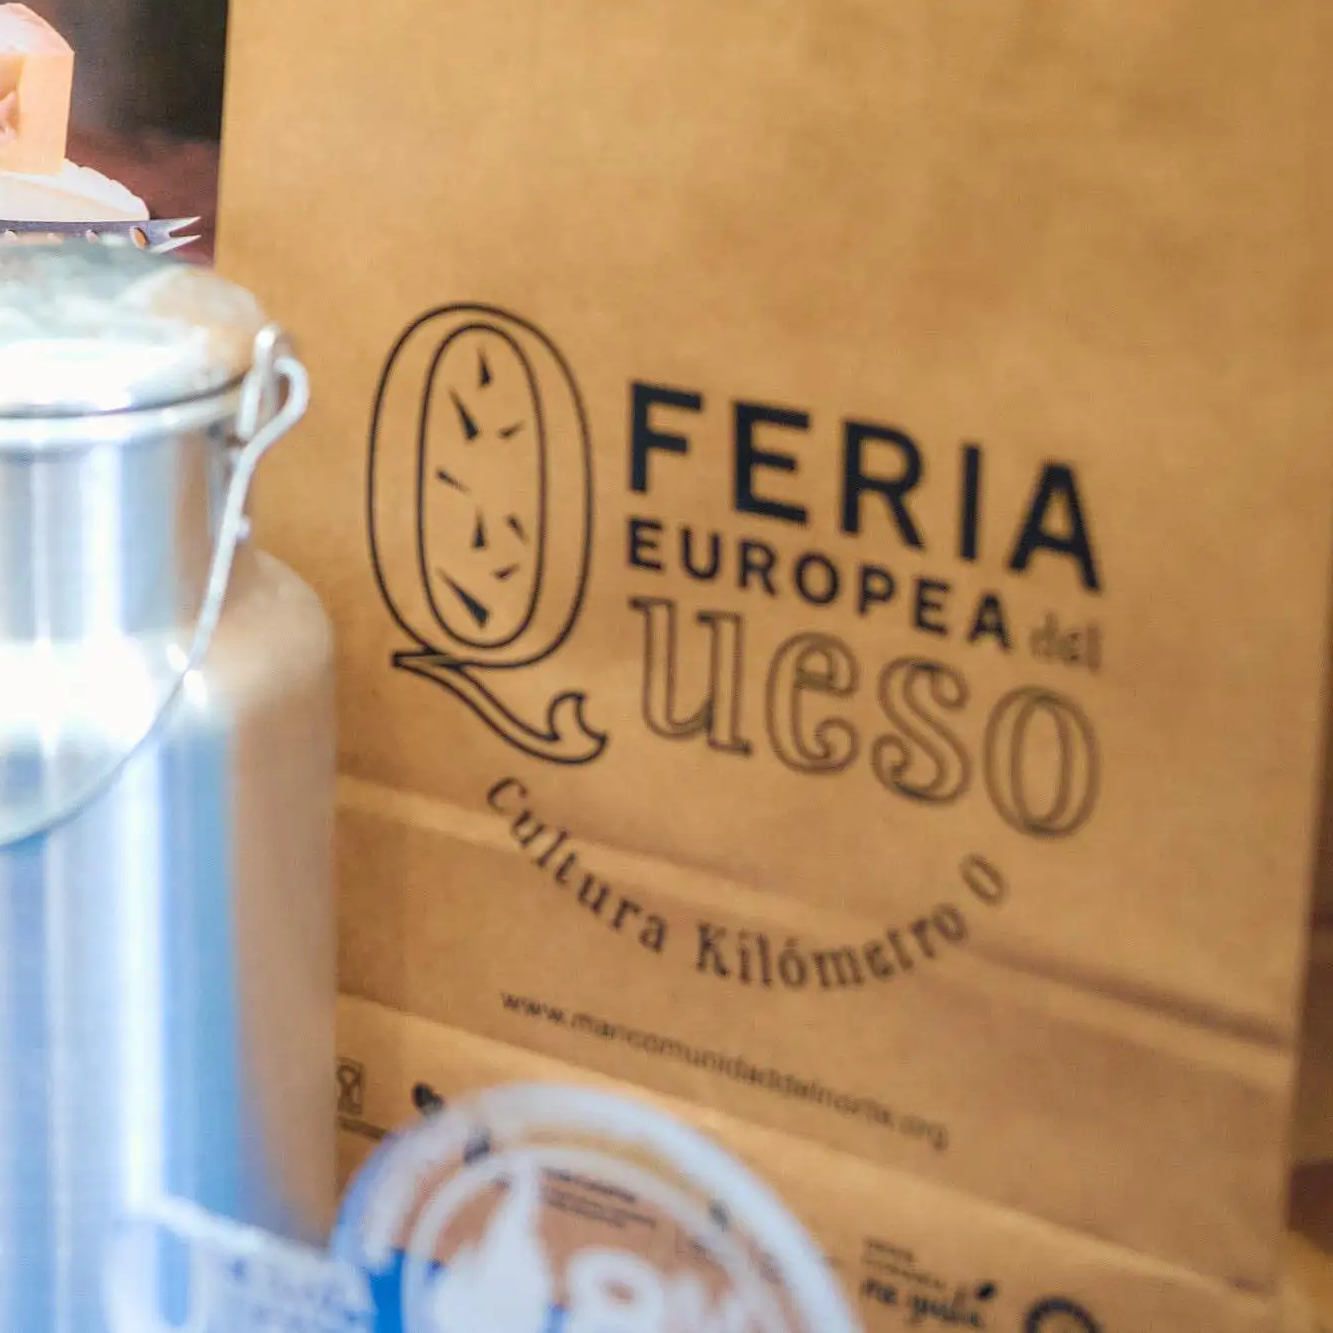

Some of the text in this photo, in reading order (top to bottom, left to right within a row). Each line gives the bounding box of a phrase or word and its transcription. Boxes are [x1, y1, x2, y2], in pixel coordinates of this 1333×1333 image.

[625, 517, 1013, 652] EUROPEA
[627, 380, 1104, 594] FERIA
[486, 774, 669, 954] Cultura
[695, 902, 969, 991] Kilómetro
